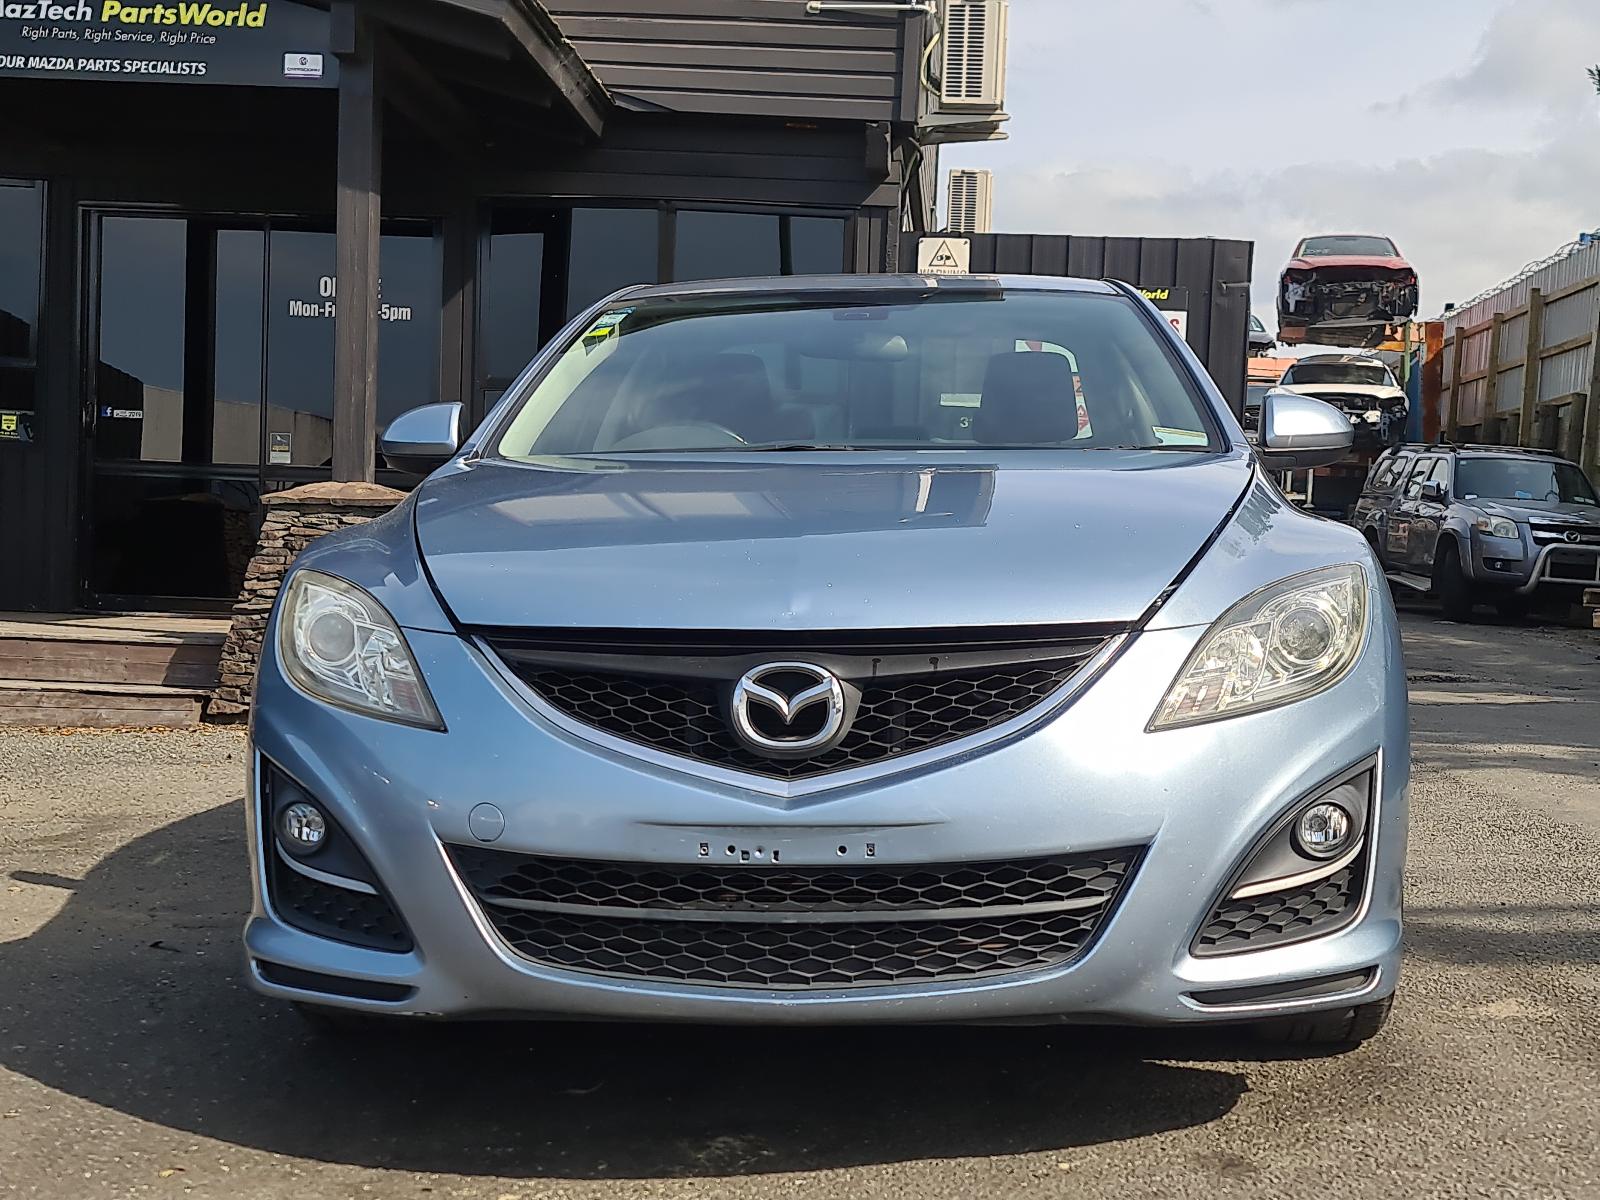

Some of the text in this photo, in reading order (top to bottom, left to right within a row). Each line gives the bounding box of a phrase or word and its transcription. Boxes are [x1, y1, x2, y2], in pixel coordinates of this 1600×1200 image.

[0, 0, 268, 27] azTech PartsWorld
[21, 25, 216, 46] Right Parts, Right Service, Right Price
[27, 56, 75, 71] MAZDA
[77, 58, 121, 72] PARTS
[123, 60, 207, 75] SPECIALISTS
